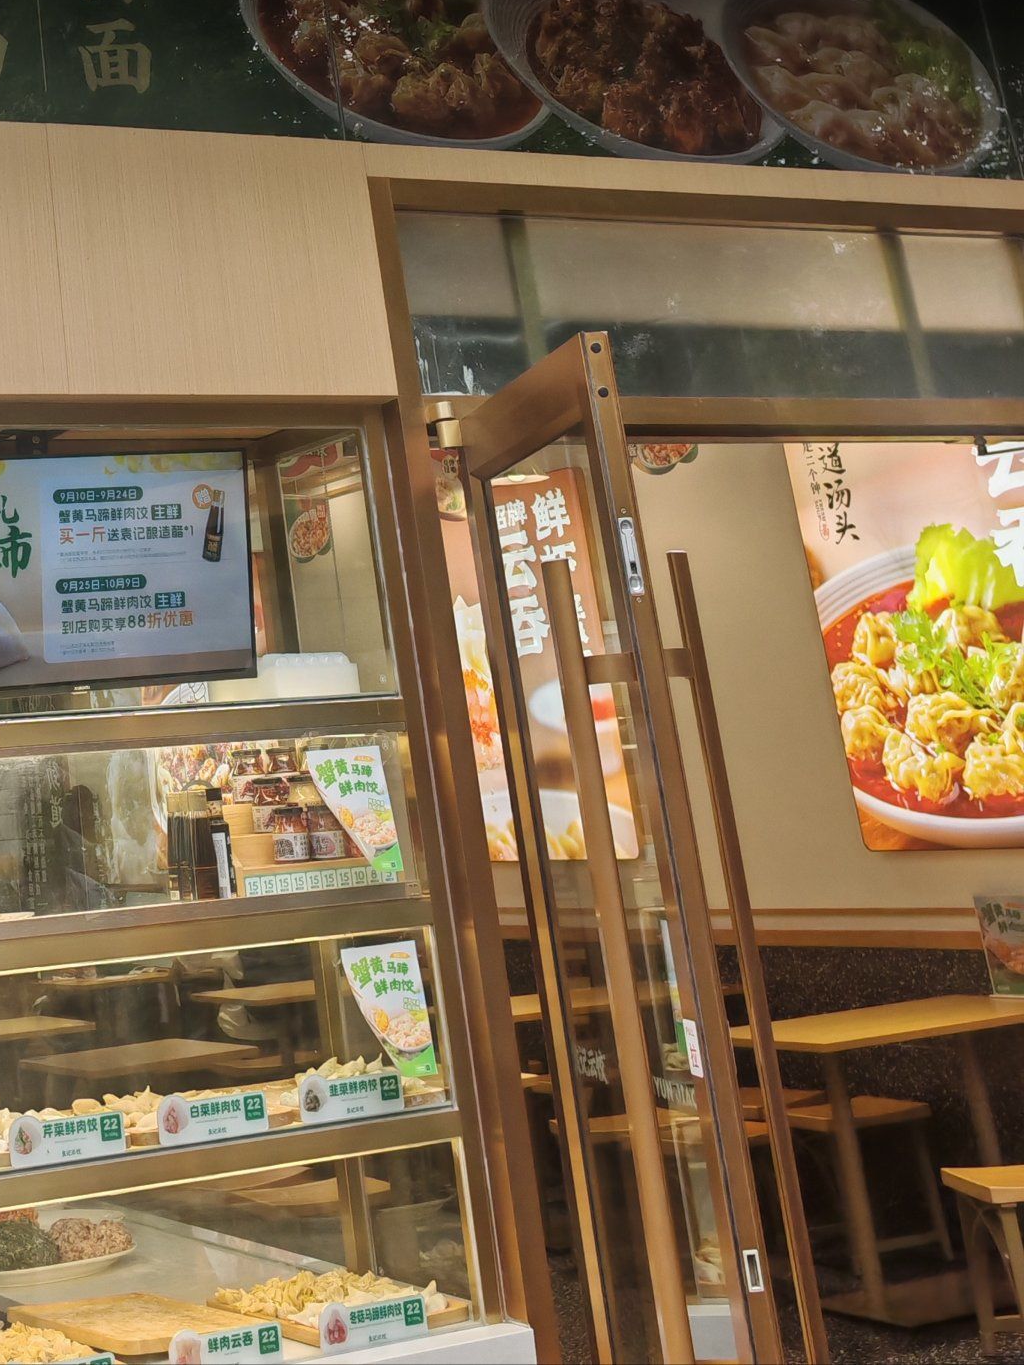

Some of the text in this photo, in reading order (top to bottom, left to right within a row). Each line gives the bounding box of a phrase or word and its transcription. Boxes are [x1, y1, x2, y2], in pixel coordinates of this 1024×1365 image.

[59, 488, 137, 502] 9月10日-9月24日
[59, 506, 148, 524] 蟹黄马蹄鲜肉饺
[62, 577, 140, 591] 9月25日-10月9日
[499, 529, 551, 658] 云吞
[61, 593, 183, 614] 蟹黄马蹄鲜肉饺 生鲜
[61, 610, 194, 635] 到店购买享88折优惠
[338, 780, 380, 798] 鲜肉饺
[248, 882, 259, 892] 15
[263, 880, 274, 890] 15
[278, 878, 289, 888] 15
[293, 876, 304, 887] 15
[309, 875, 320, 885] 15
[324, 873, 335, 884] 15
[339, 872, 350, 882] 15
[354, 870, 365, 881] 10
[373, 978, 416, 998] 鲜肉饺
[328, 1078, 378, 1097] 韭菜鲜肉饺
[382, 1079, 396, 1090] 22
[189, 1099, 241, 1118] 白菜鲜肉饺
[246, 1098, 261, 1110] 22
[42, 1117, 98, 1138] 芹菜鲜肉饺
[103, 1118, 118, 1130] 22
[406, 1302, 421, 1314] 22
[207, 1330, 254, 1353] 鲜肉云吞
[261, 1329, 276, 1343] 22
